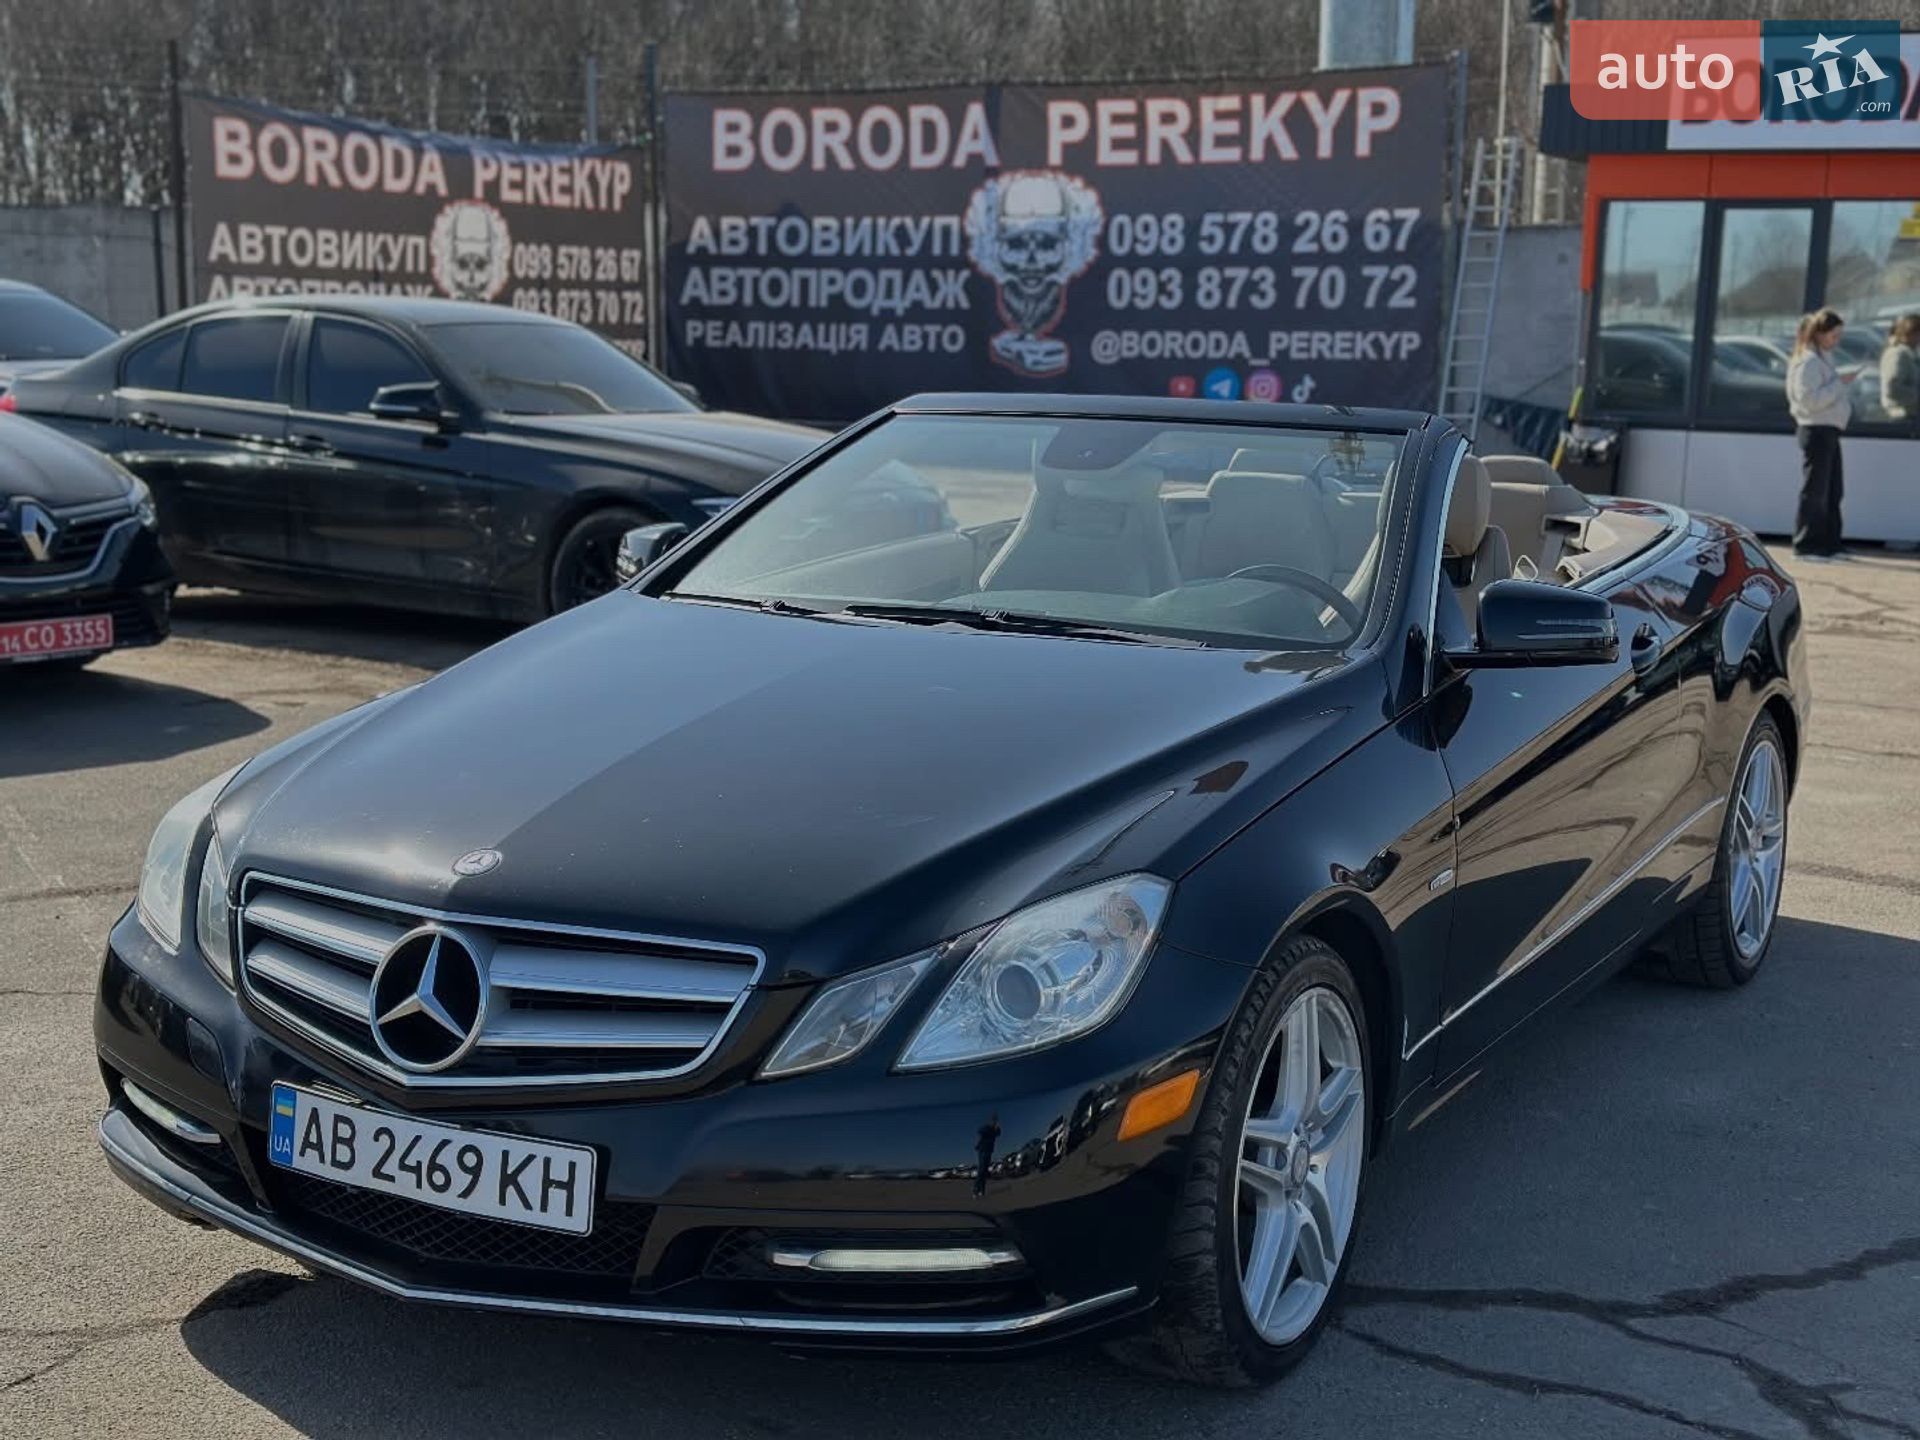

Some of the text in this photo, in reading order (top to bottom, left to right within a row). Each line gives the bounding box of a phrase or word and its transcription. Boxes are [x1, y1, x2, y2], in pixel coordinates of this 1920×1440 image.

[712, 86, 1402, 172] BORODA PEREKYP
[212, 116, 631, 211] BORODA PEREKYP
[207, 221, 428, 274] АВТОВИКУП
[686, 216, 962, 257] АВТОВИКУП
[1108, 208, 1421, 257] 098 578 26 67
[556, 245, 593, 281] 578
[595, 289, 620, 325] 70
[621, 290, 645, 326] 72
[680, 267, 972, 316] АВТОПРОДАЖ
[1106, 265, 1418, 310] 093 873 70 72
[686, 320, 966, 355] РЕАЛІЗАЦІЯ АВТО
[1091, 329, 1422, 366] @BORODA_PEREKYP
[62, 619, 106, 647] 3355
[273, 1133, 292, 1156] UA
[298, 1106, 578, 1218] AB 2469 KH
